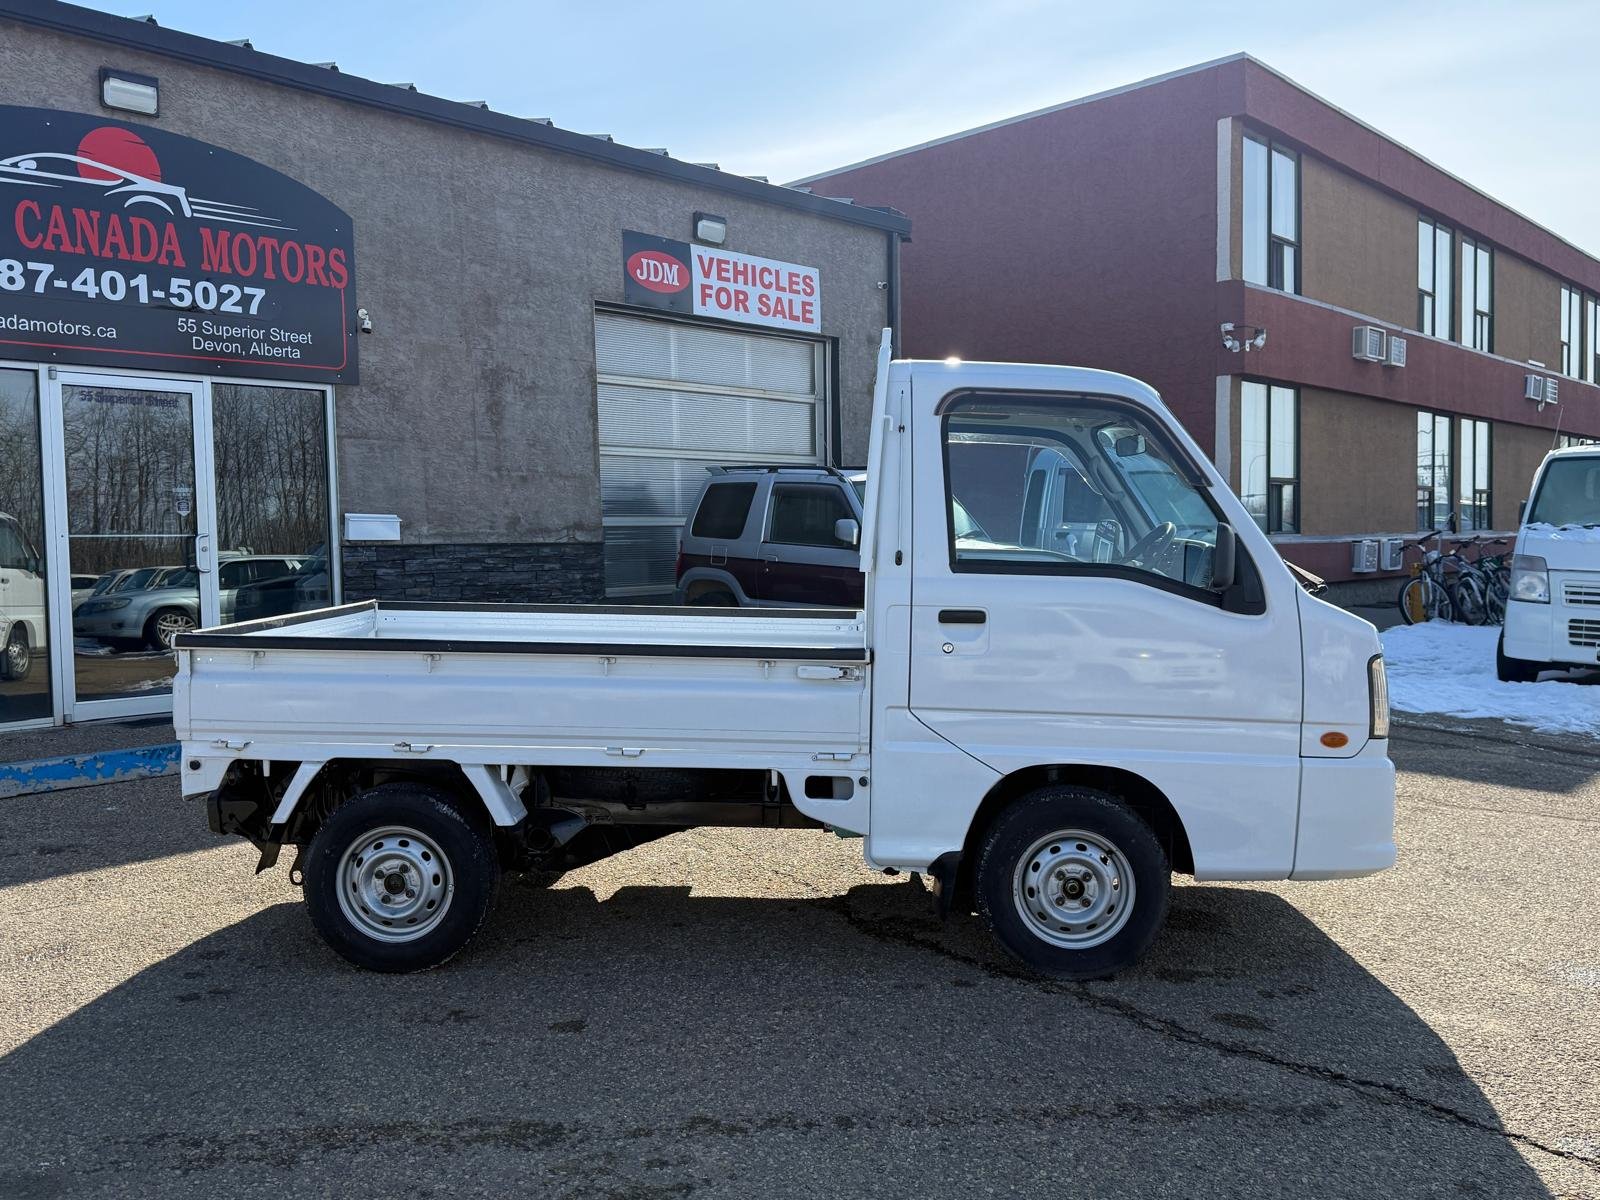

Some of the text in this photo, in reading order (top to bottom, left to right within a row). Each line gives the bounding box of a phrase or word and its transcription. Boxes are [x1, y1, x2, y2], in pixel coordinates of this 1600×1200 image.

[15, 199, 348, 289] CANADA MOTORS
[0, 258, 266, 315] 87-401-5027
[636, 257, 680, 286] JDM
[697, 254, 815, 297] VEHICLES
[700, 283, 814, 324] FOR SALE
[177, 317, 312, 345] 55 Superior Street
[192, 336, 301, 359] Devon, Alberta
